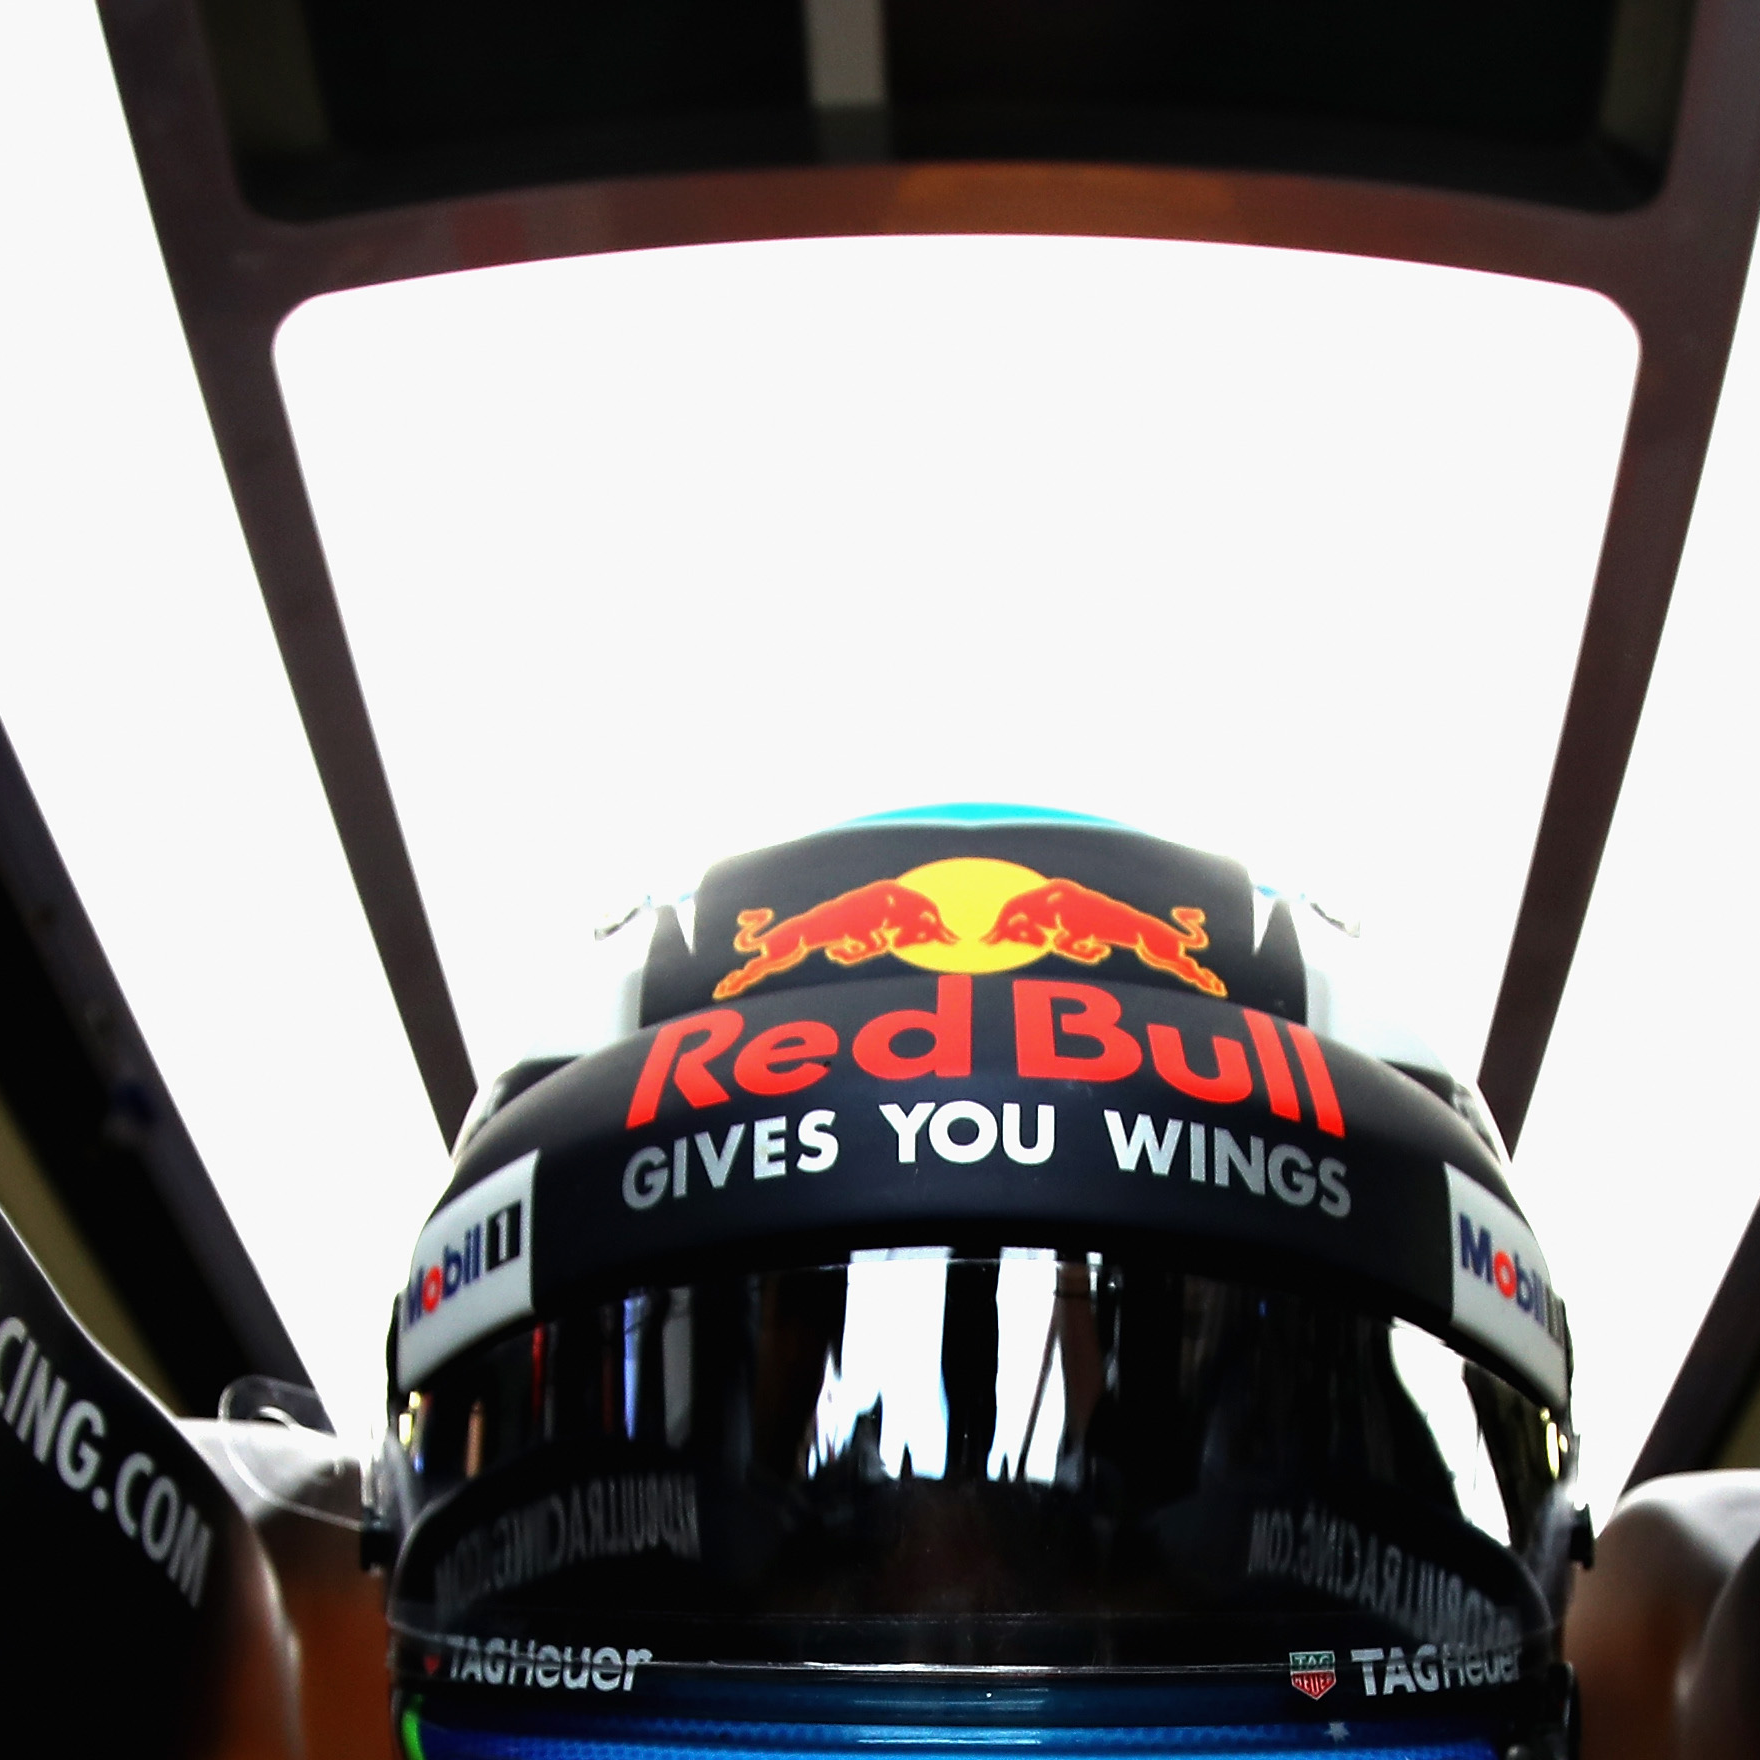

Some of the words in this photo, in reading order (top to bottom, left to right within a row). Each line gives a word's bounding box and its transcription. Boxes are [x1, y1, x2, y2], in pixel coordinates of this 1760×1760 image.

[625, 974, 974, 1131] Red
[1013, 979, 1347, 1140] Bull
[621, 1108, 840, 1212] GIVES
[879, 1098, 1057, 1166] YOU
[1102, 1108, 1352, 1219] WINGS
[407, 1223, 481, 1326] Mobil
[1459, 1213, 1545, 1328] Mobil
